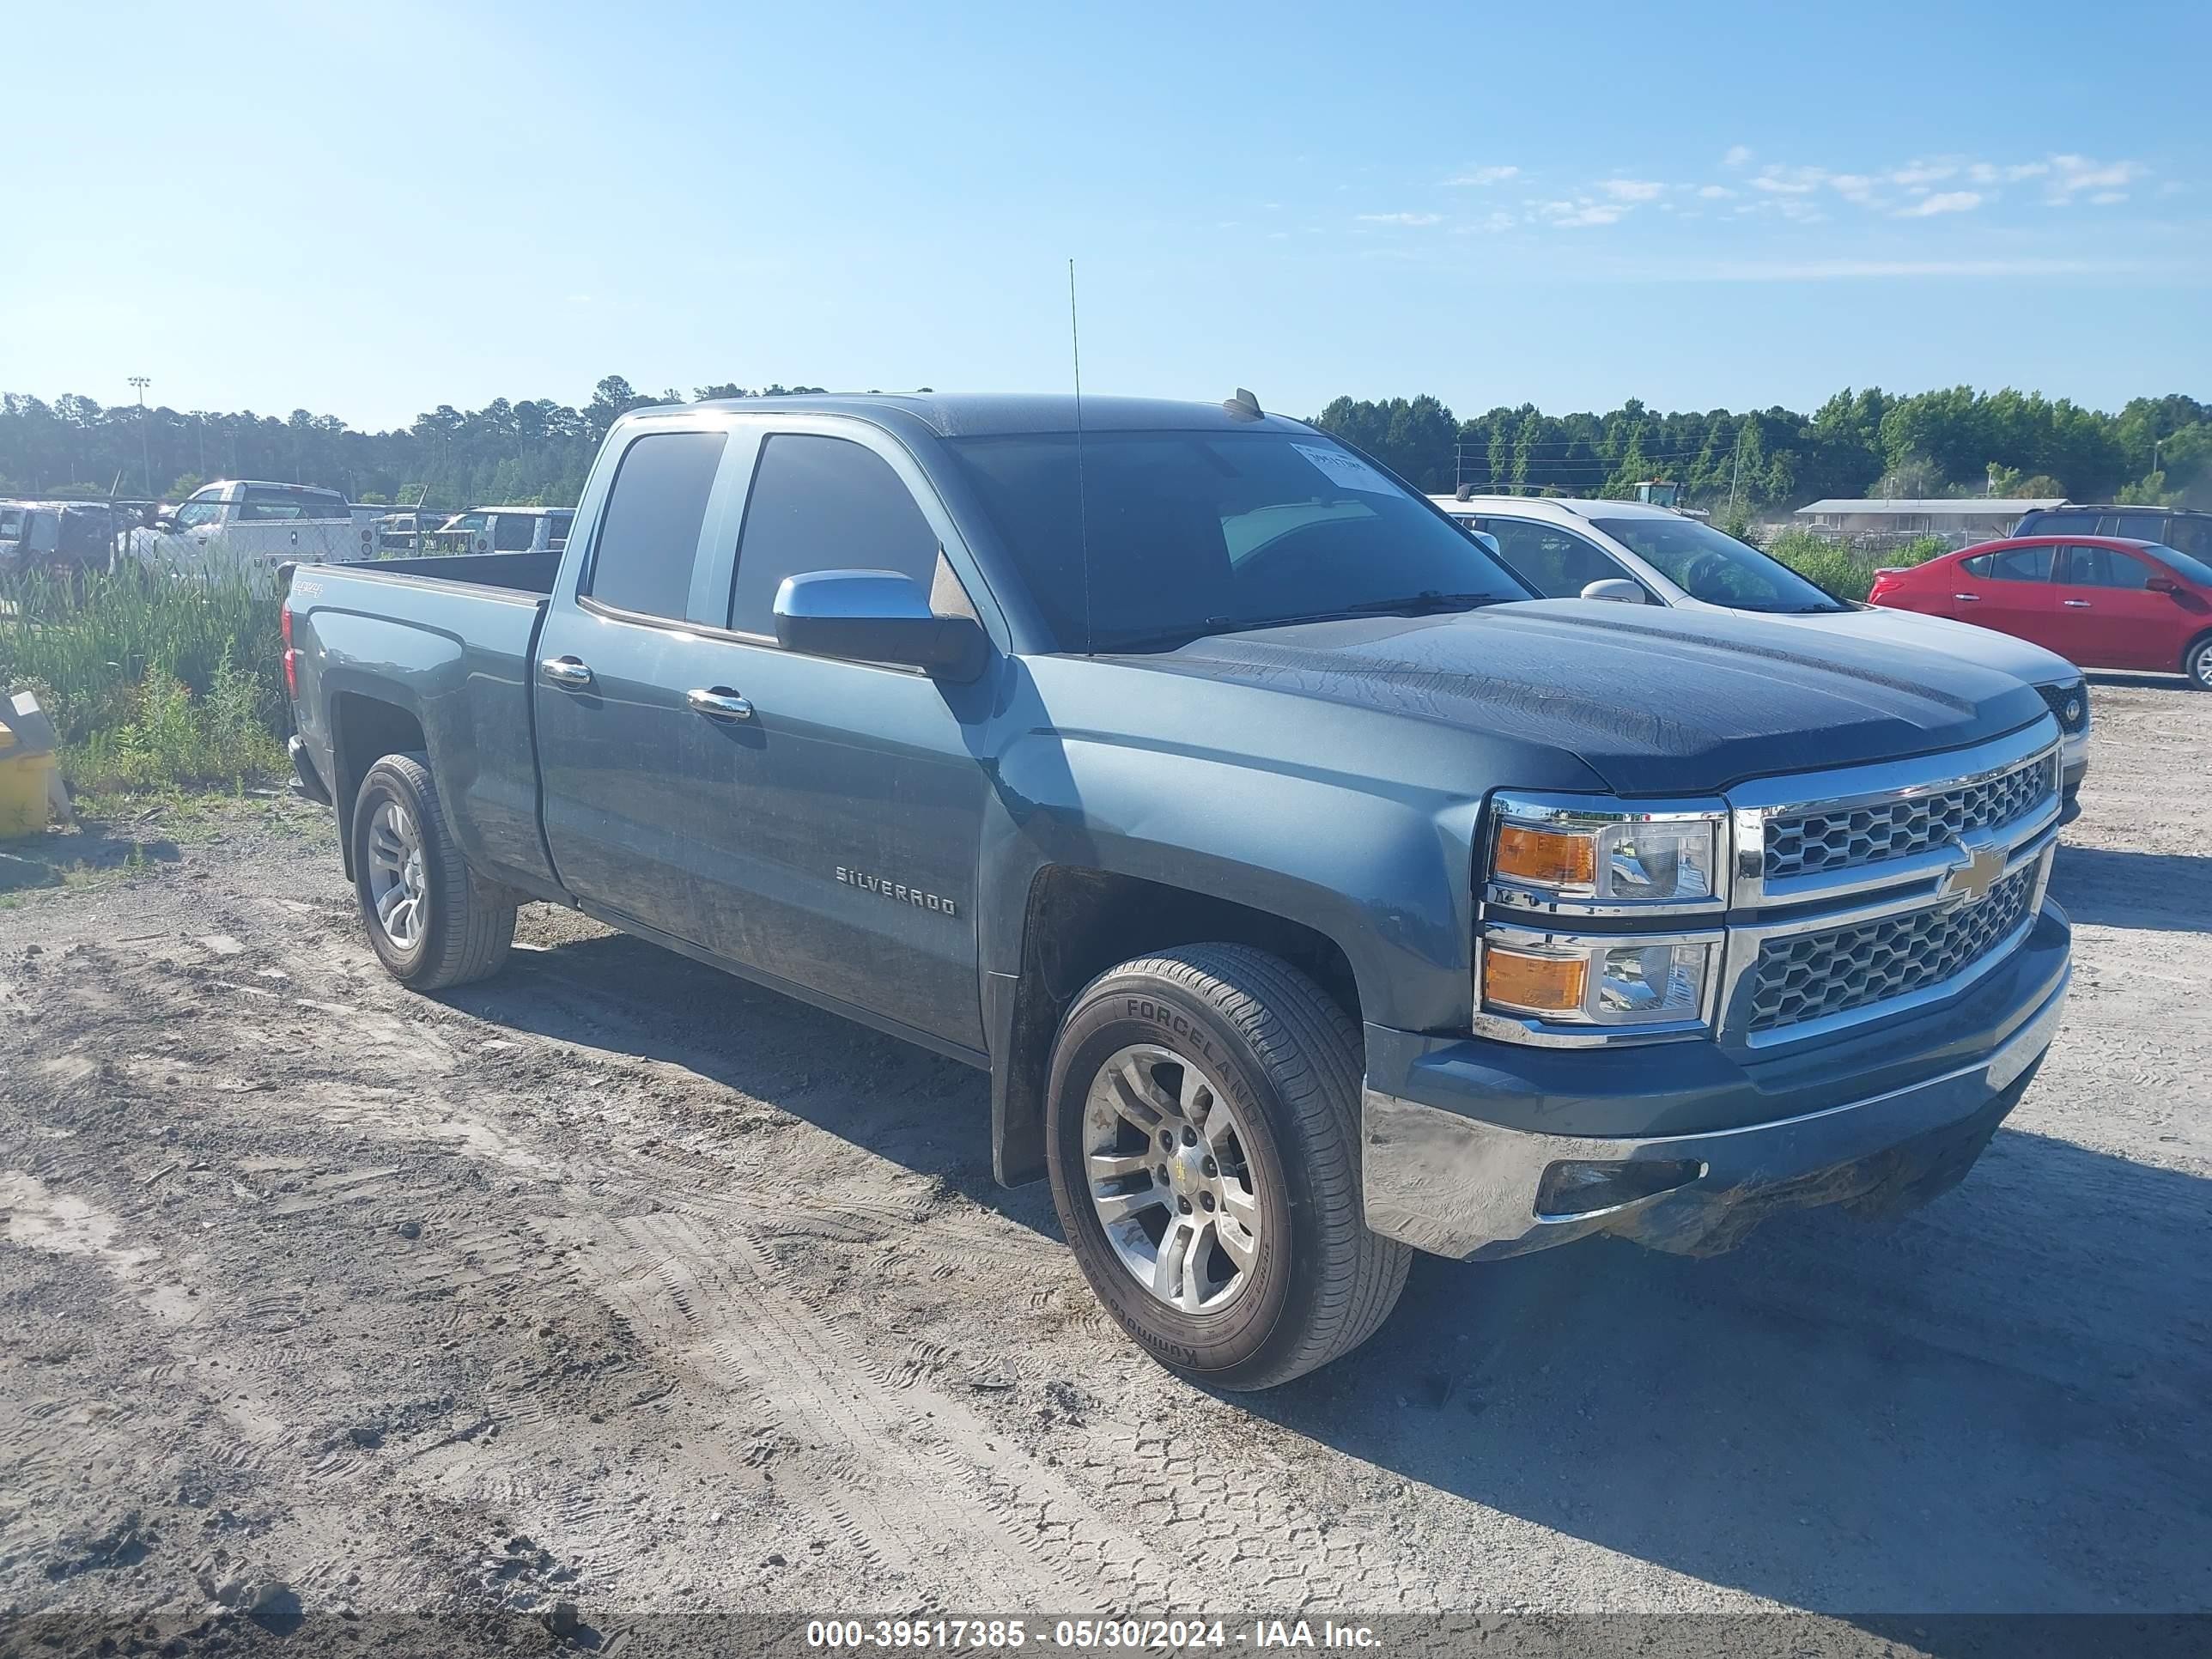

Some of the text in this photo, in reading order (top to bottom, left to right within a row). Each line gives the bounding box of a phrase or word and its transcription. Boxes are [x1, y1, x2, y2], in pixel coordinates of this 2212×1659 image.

[836, 866, 955, 916] SILVERADO
[1127, 999, 1260, 1127] FORCELAND
[1109, 1297, 1199, 1367] Kunimoto
